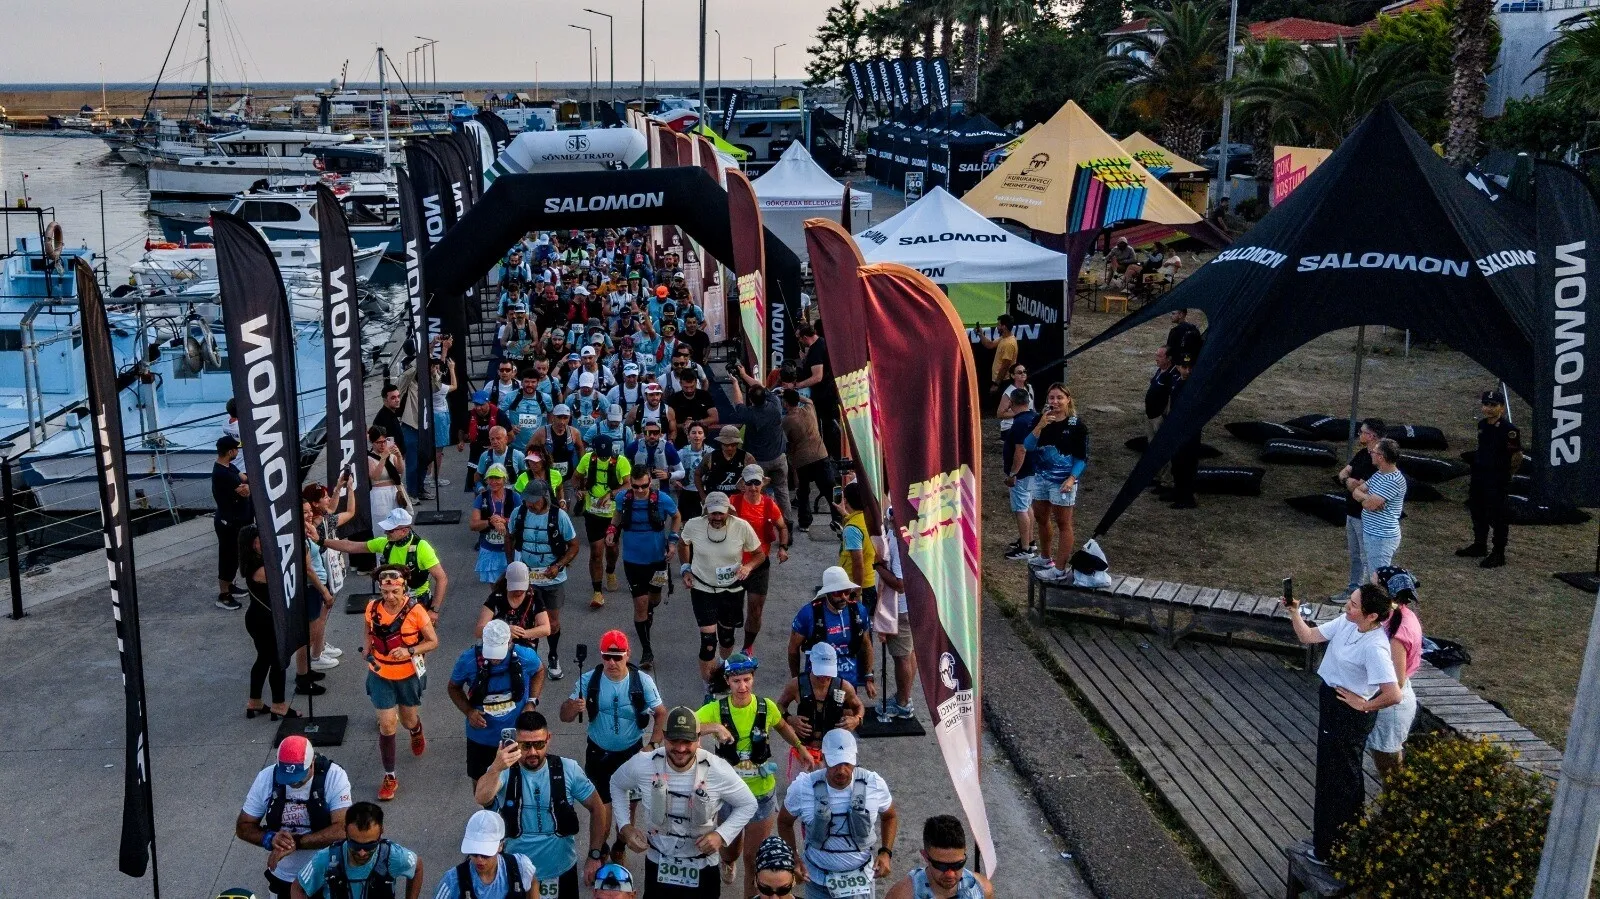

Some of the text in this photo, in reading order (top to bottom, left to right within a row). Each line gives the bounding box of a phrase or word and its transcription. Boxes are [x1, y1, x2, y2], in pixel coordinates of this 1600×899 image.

[724, 93, 737, 131] SALOMON
[842, 109, 852, 157] SALOMON
[541, 151, 615, 162] SÖNMEZ TRAFO
[909, 180, 922, 188] 40
[544, 192, 665, 214] SALOMON
[898, 232, 1008, 246] SALOMON
[1211, 246, 1288, 270] SALOMON
[1296, 252, 1469, 278] SALOMON
[1016, 293, 1059, 325] SALOMON
[772, 302, 785, 371] OMON
[519, 418, 538, 426] 3029
[486, 533, 504, 542] 306
[659, 863, 699, 880] 3010
[539, 883, 558, 897] 65
[827, 876, 867, 892] 3089
